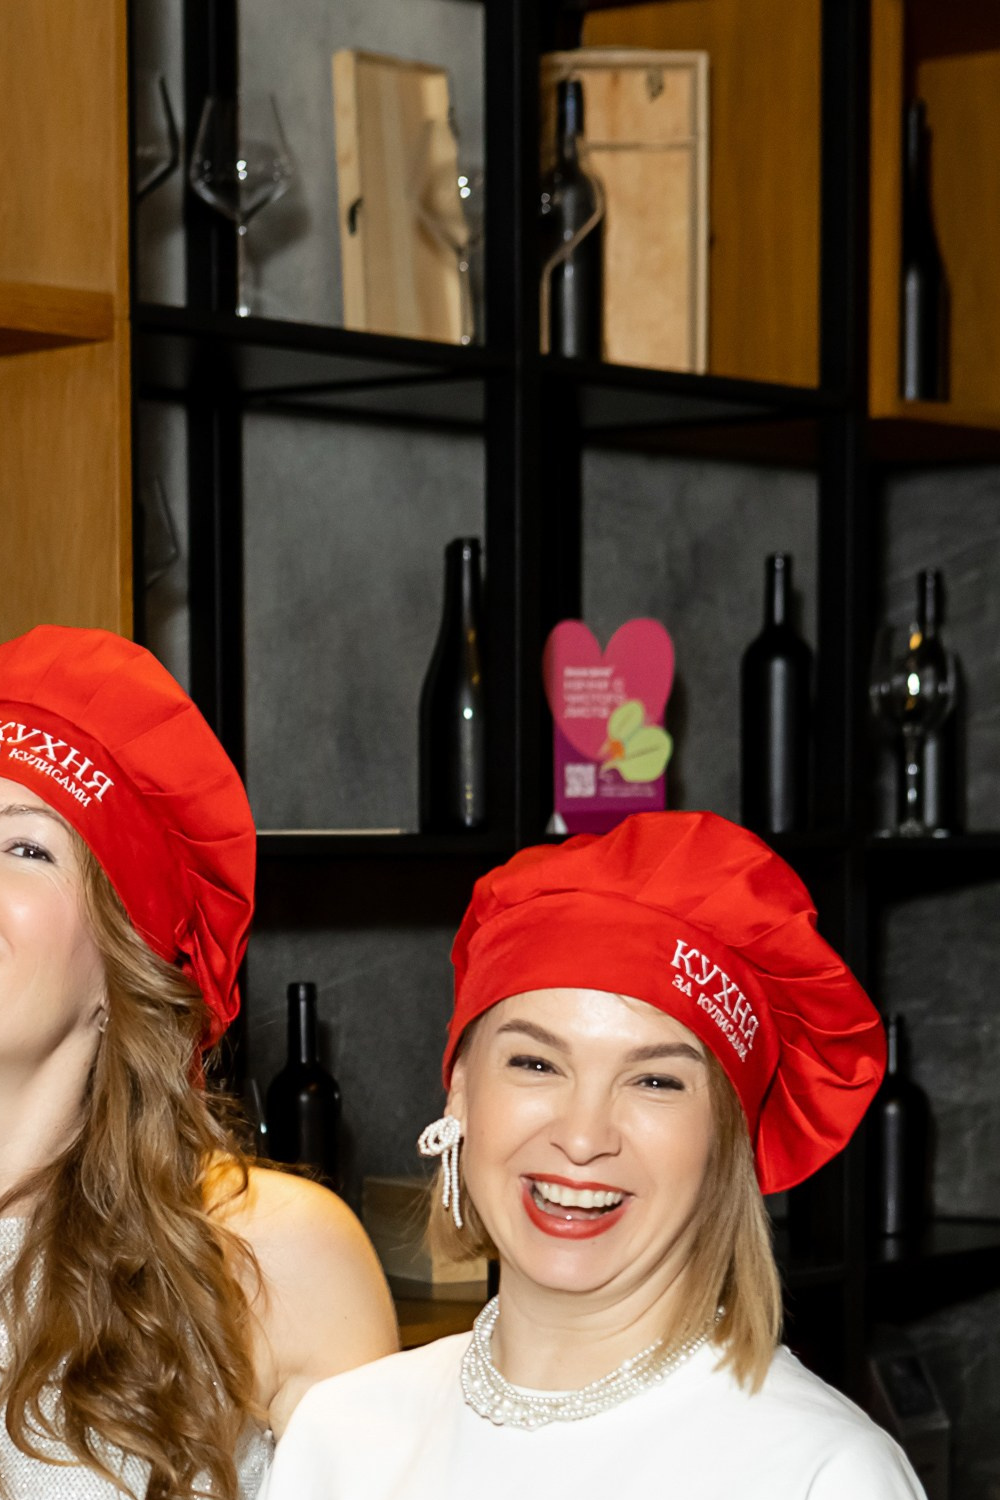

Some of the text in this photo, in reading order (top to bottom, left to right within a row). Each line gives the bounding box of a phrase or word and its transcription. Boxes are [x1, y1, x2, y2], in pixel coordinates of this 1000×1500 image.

[8, 748, 92, 807] КУЛИСАМИ
[670, 939, 759, 1050] КУХНЯ
[672, 974, 692, 997] ЗА
